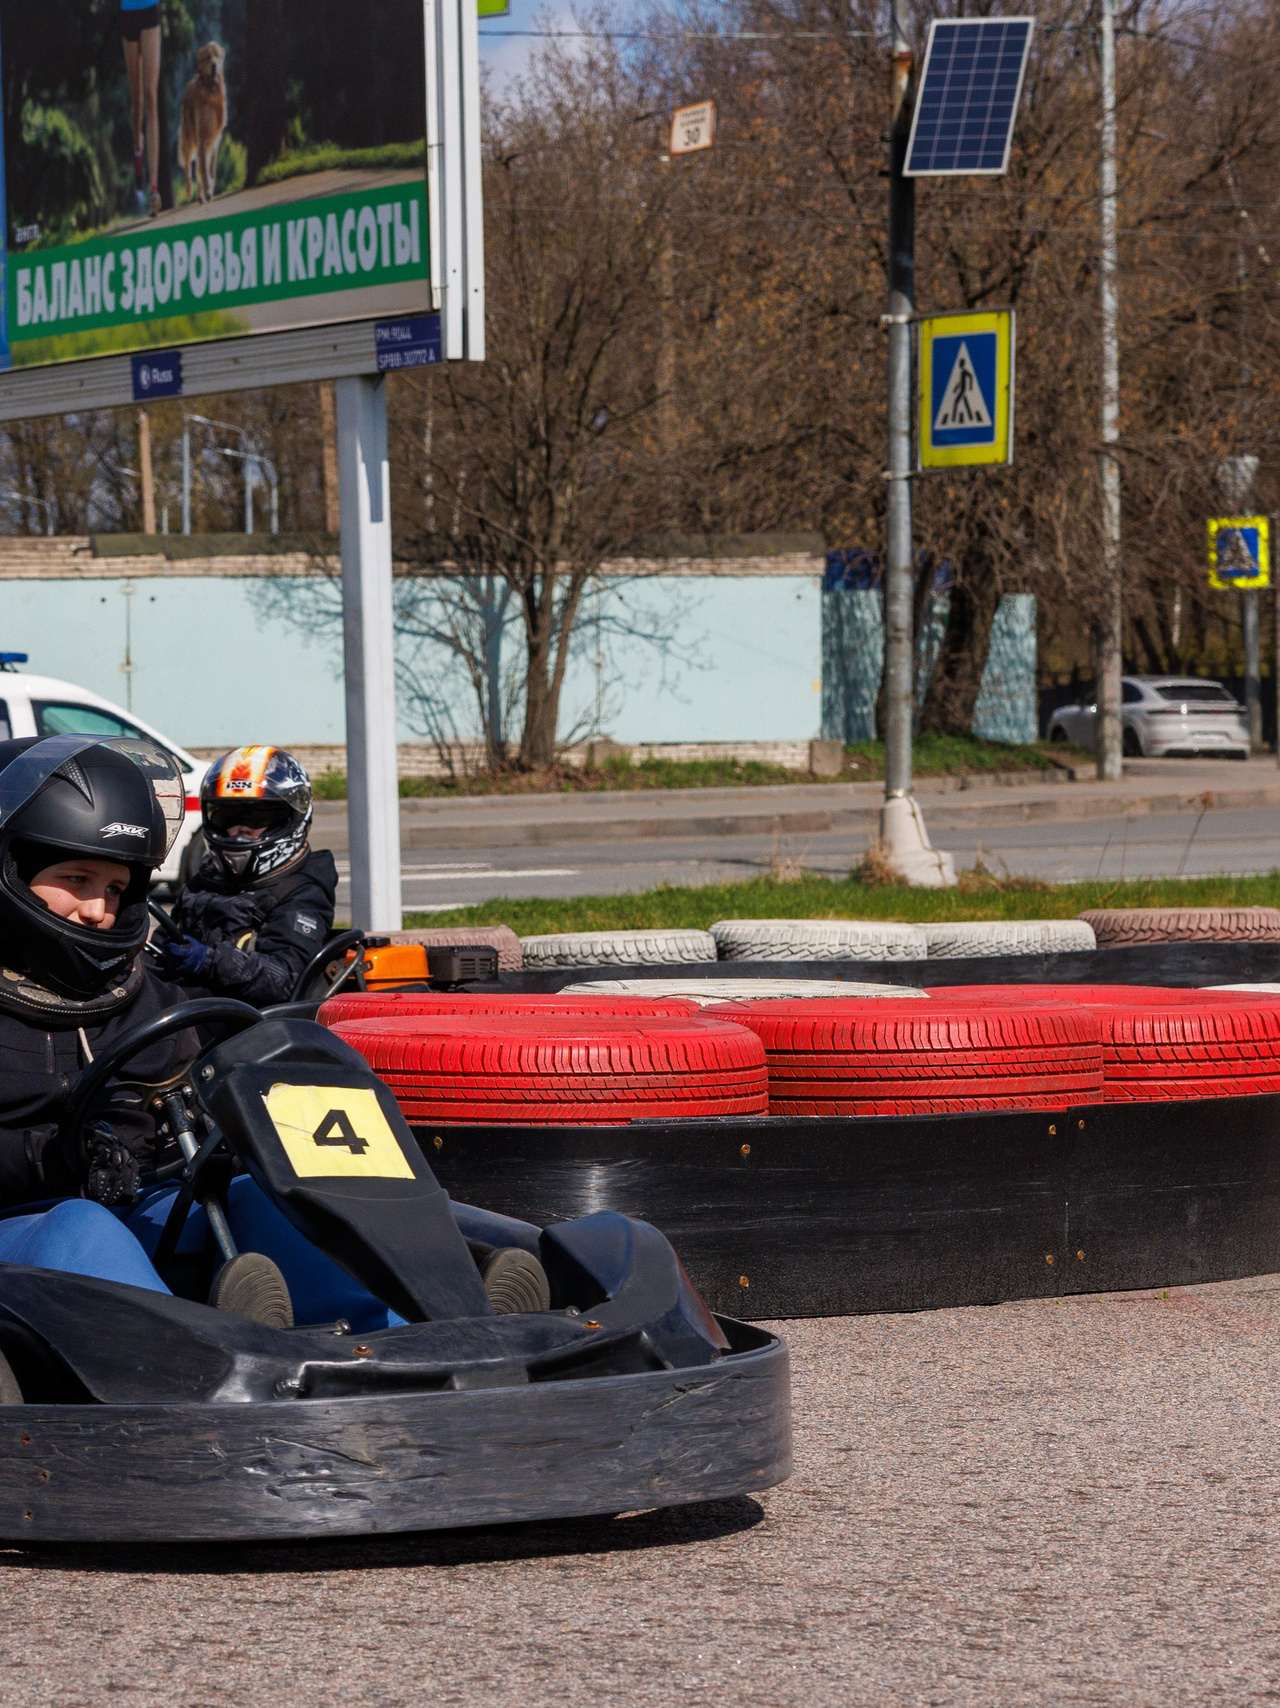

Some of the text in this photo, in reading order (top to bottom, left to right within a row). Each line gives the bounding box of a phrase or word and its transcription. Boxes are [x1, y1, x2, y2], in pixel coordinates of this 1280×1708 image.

[16, 250, 116, 327] БАЛАНС
[120, 226, 258, 315] ЗДОРОВЬЯ
[262, 223, 282, 286] И
[286, 199, 421, 283] КРАСОТЫ
[312, 1109, 370, 1155] 4
